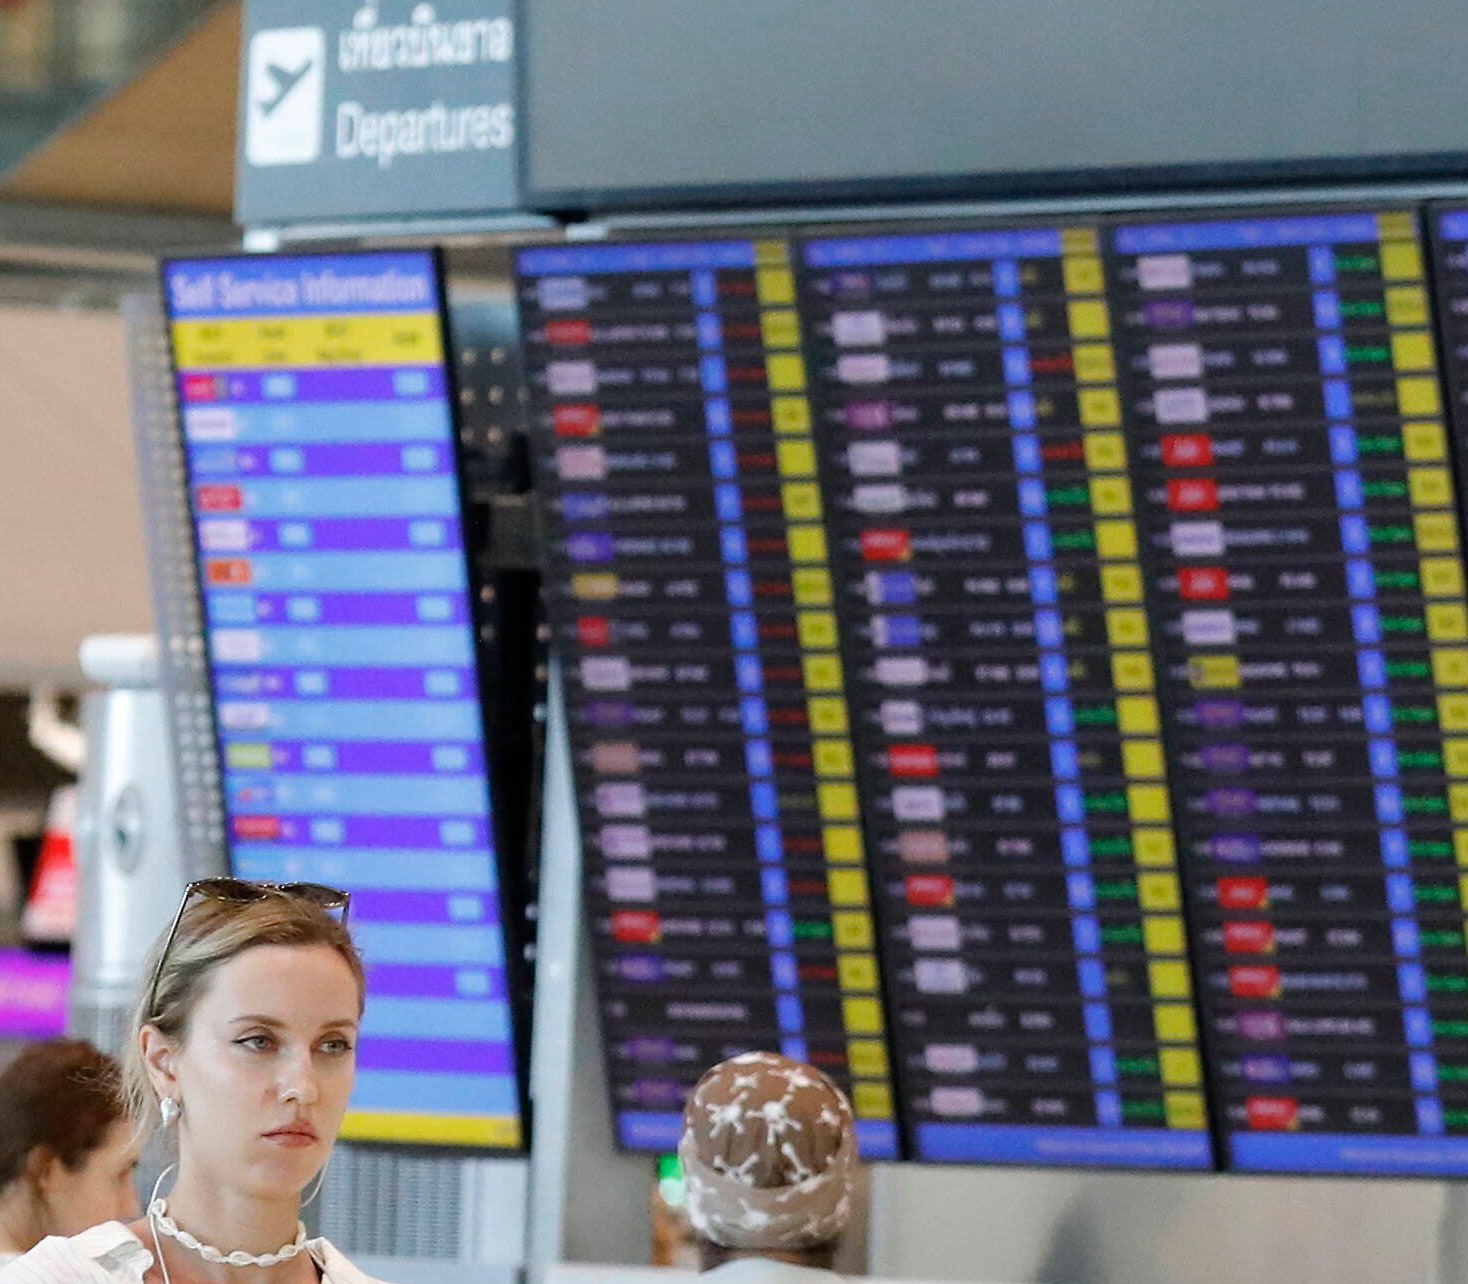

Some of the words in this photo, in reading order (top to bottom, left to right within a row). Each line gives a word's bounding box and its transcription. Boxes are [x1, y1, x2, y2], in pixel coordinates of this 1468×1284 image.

[336, 100, 514, 169] Departures
[218, 270, 298, 309] Service
[300, 267, 432, 306] Information
